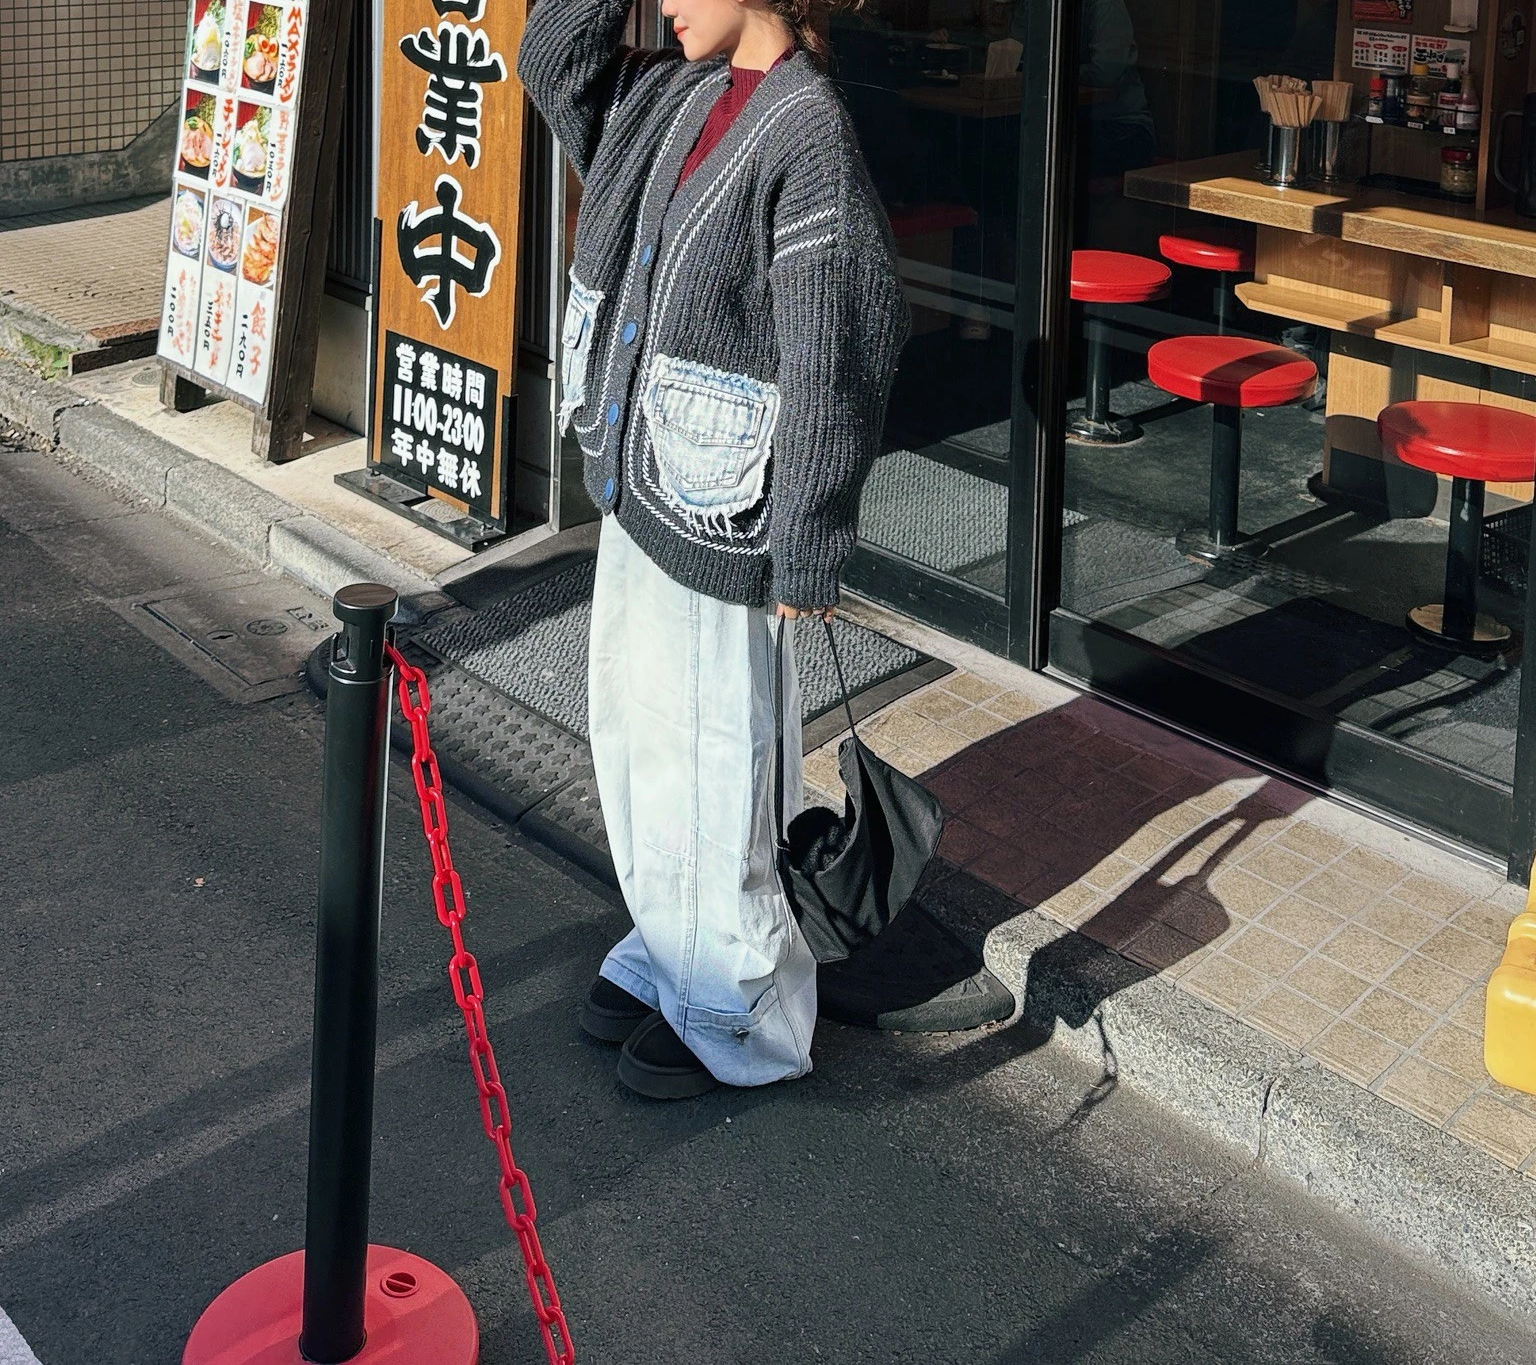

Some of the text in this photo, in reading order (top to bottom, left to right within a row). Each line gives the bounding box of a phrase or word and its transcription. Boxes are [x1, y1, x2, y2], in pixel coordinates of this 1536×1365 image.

[395, 342, 486, 410] 営業時間
[391, 427, 482, 499] 年中無休
